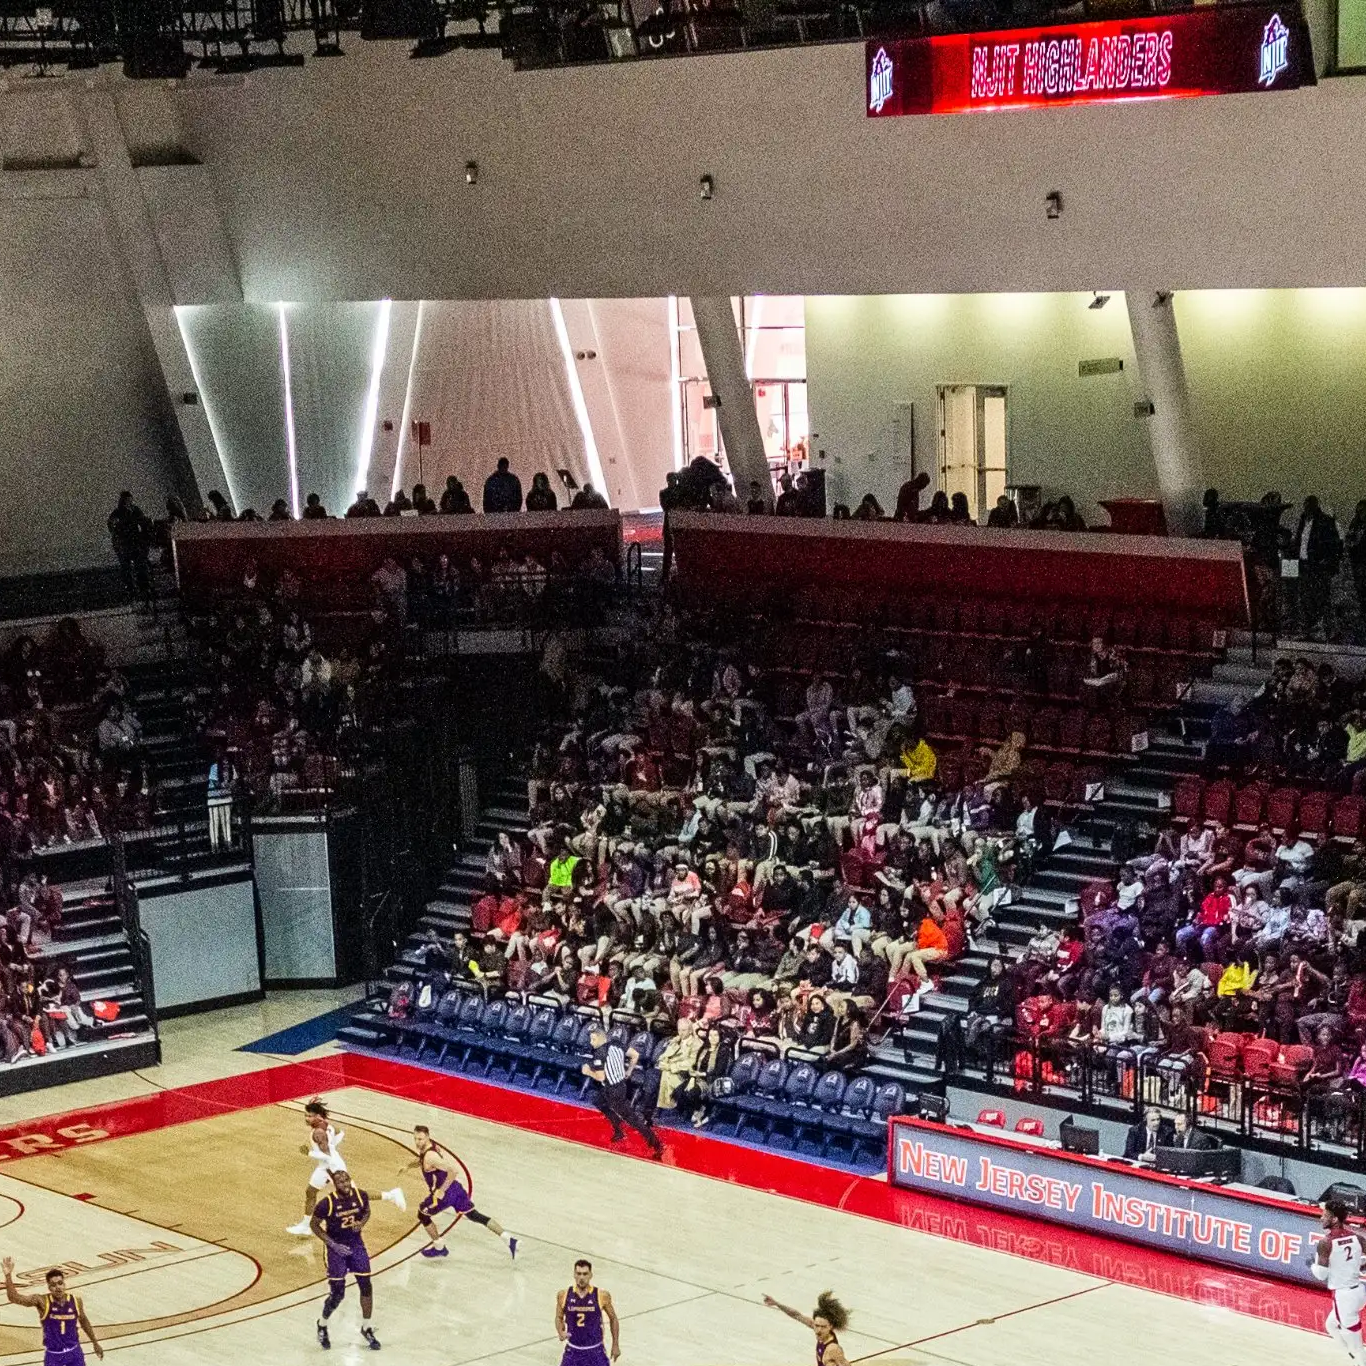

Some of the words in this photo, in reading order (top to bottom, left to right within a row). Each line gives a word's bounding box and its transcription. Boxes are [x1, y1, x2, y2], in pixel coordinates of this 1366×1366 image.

[970, 44, 1019, 98] NJIT
[1023, 30, 1173, 94] HIGHLANDERS
[898, 1138, 968, 1187] NEW
[976, 1155, 1082, 1212] JERSEY
[1092, 1181, 1253, 1255] INSTITUTE
[1259, 1228, 1302, 1264] OF
[1343, 1245, 1353, 1262] 2
[60, 1320, 66, 1335] 1
[576, 1313, 585, 1327] 2
